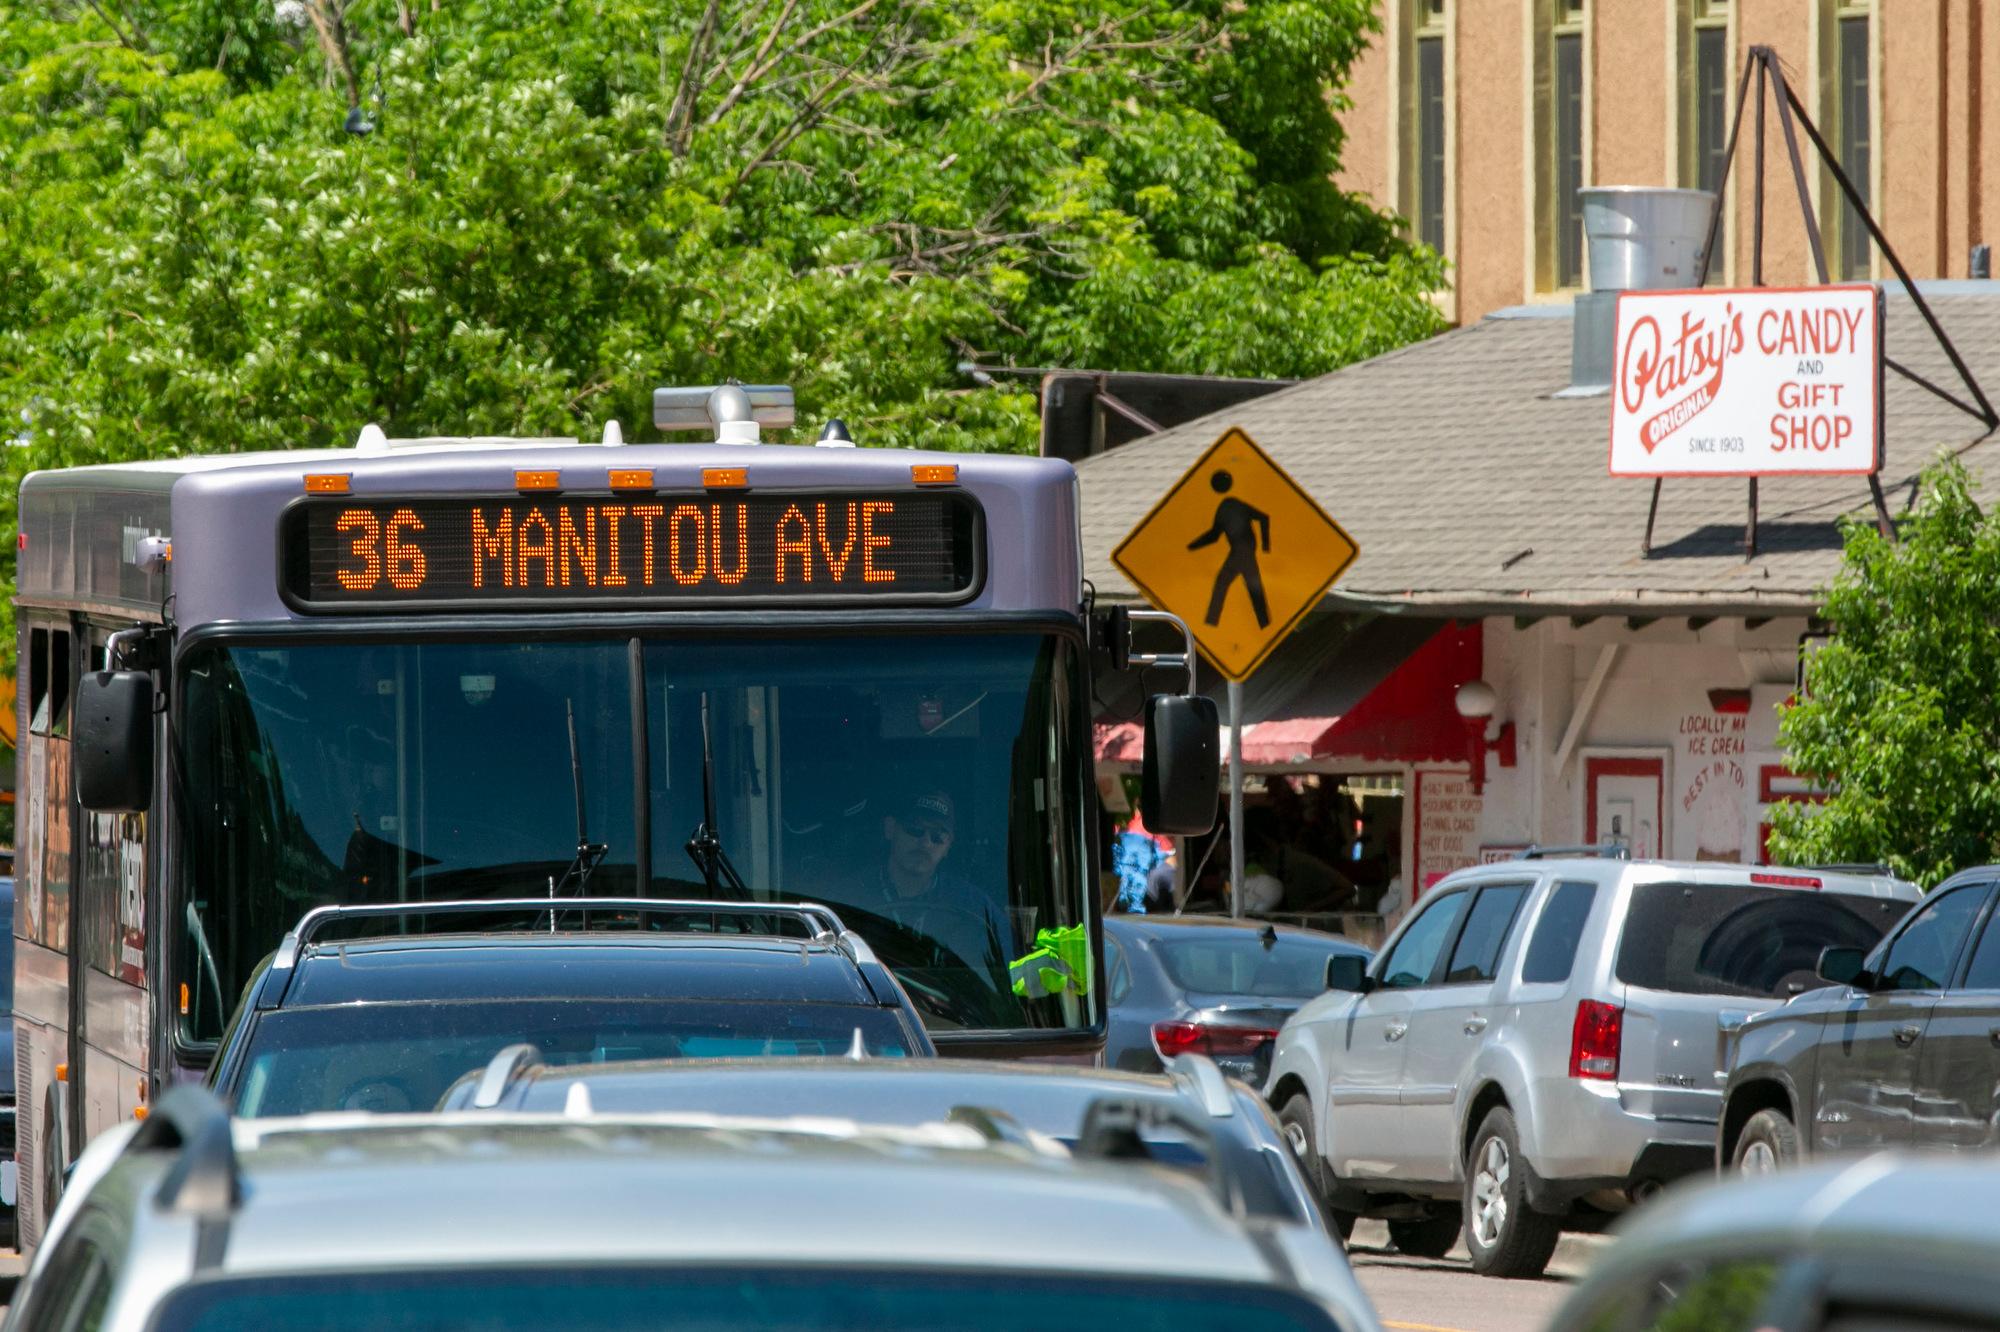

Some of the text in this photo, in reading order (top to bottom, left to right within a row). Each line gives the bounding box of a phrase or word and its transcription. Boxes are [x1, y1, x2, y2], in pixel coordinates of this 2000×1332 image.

[1757, 307, 1864, 355] CANDY
[1621, 301, 1744, 414] Patsy's
[1797, 360, 1824, 375] AND
[1648, 384, 1713, 444] ORIGINAL
[1778, 381, 1844, 409] GIFT
[1689, 436, 1744, 453] SINCE 1903
[1770, 413, 1852, 452] SHOP
[332, 501, 895, 590] 36 MANITOU AVE
[1680, 715, 1727, 734] LOCALLY
[1689, 738, 1706, 755] ICE
[1683, 766, 1709, 813] BEST
[1714, 760, 1725, 777] IN
